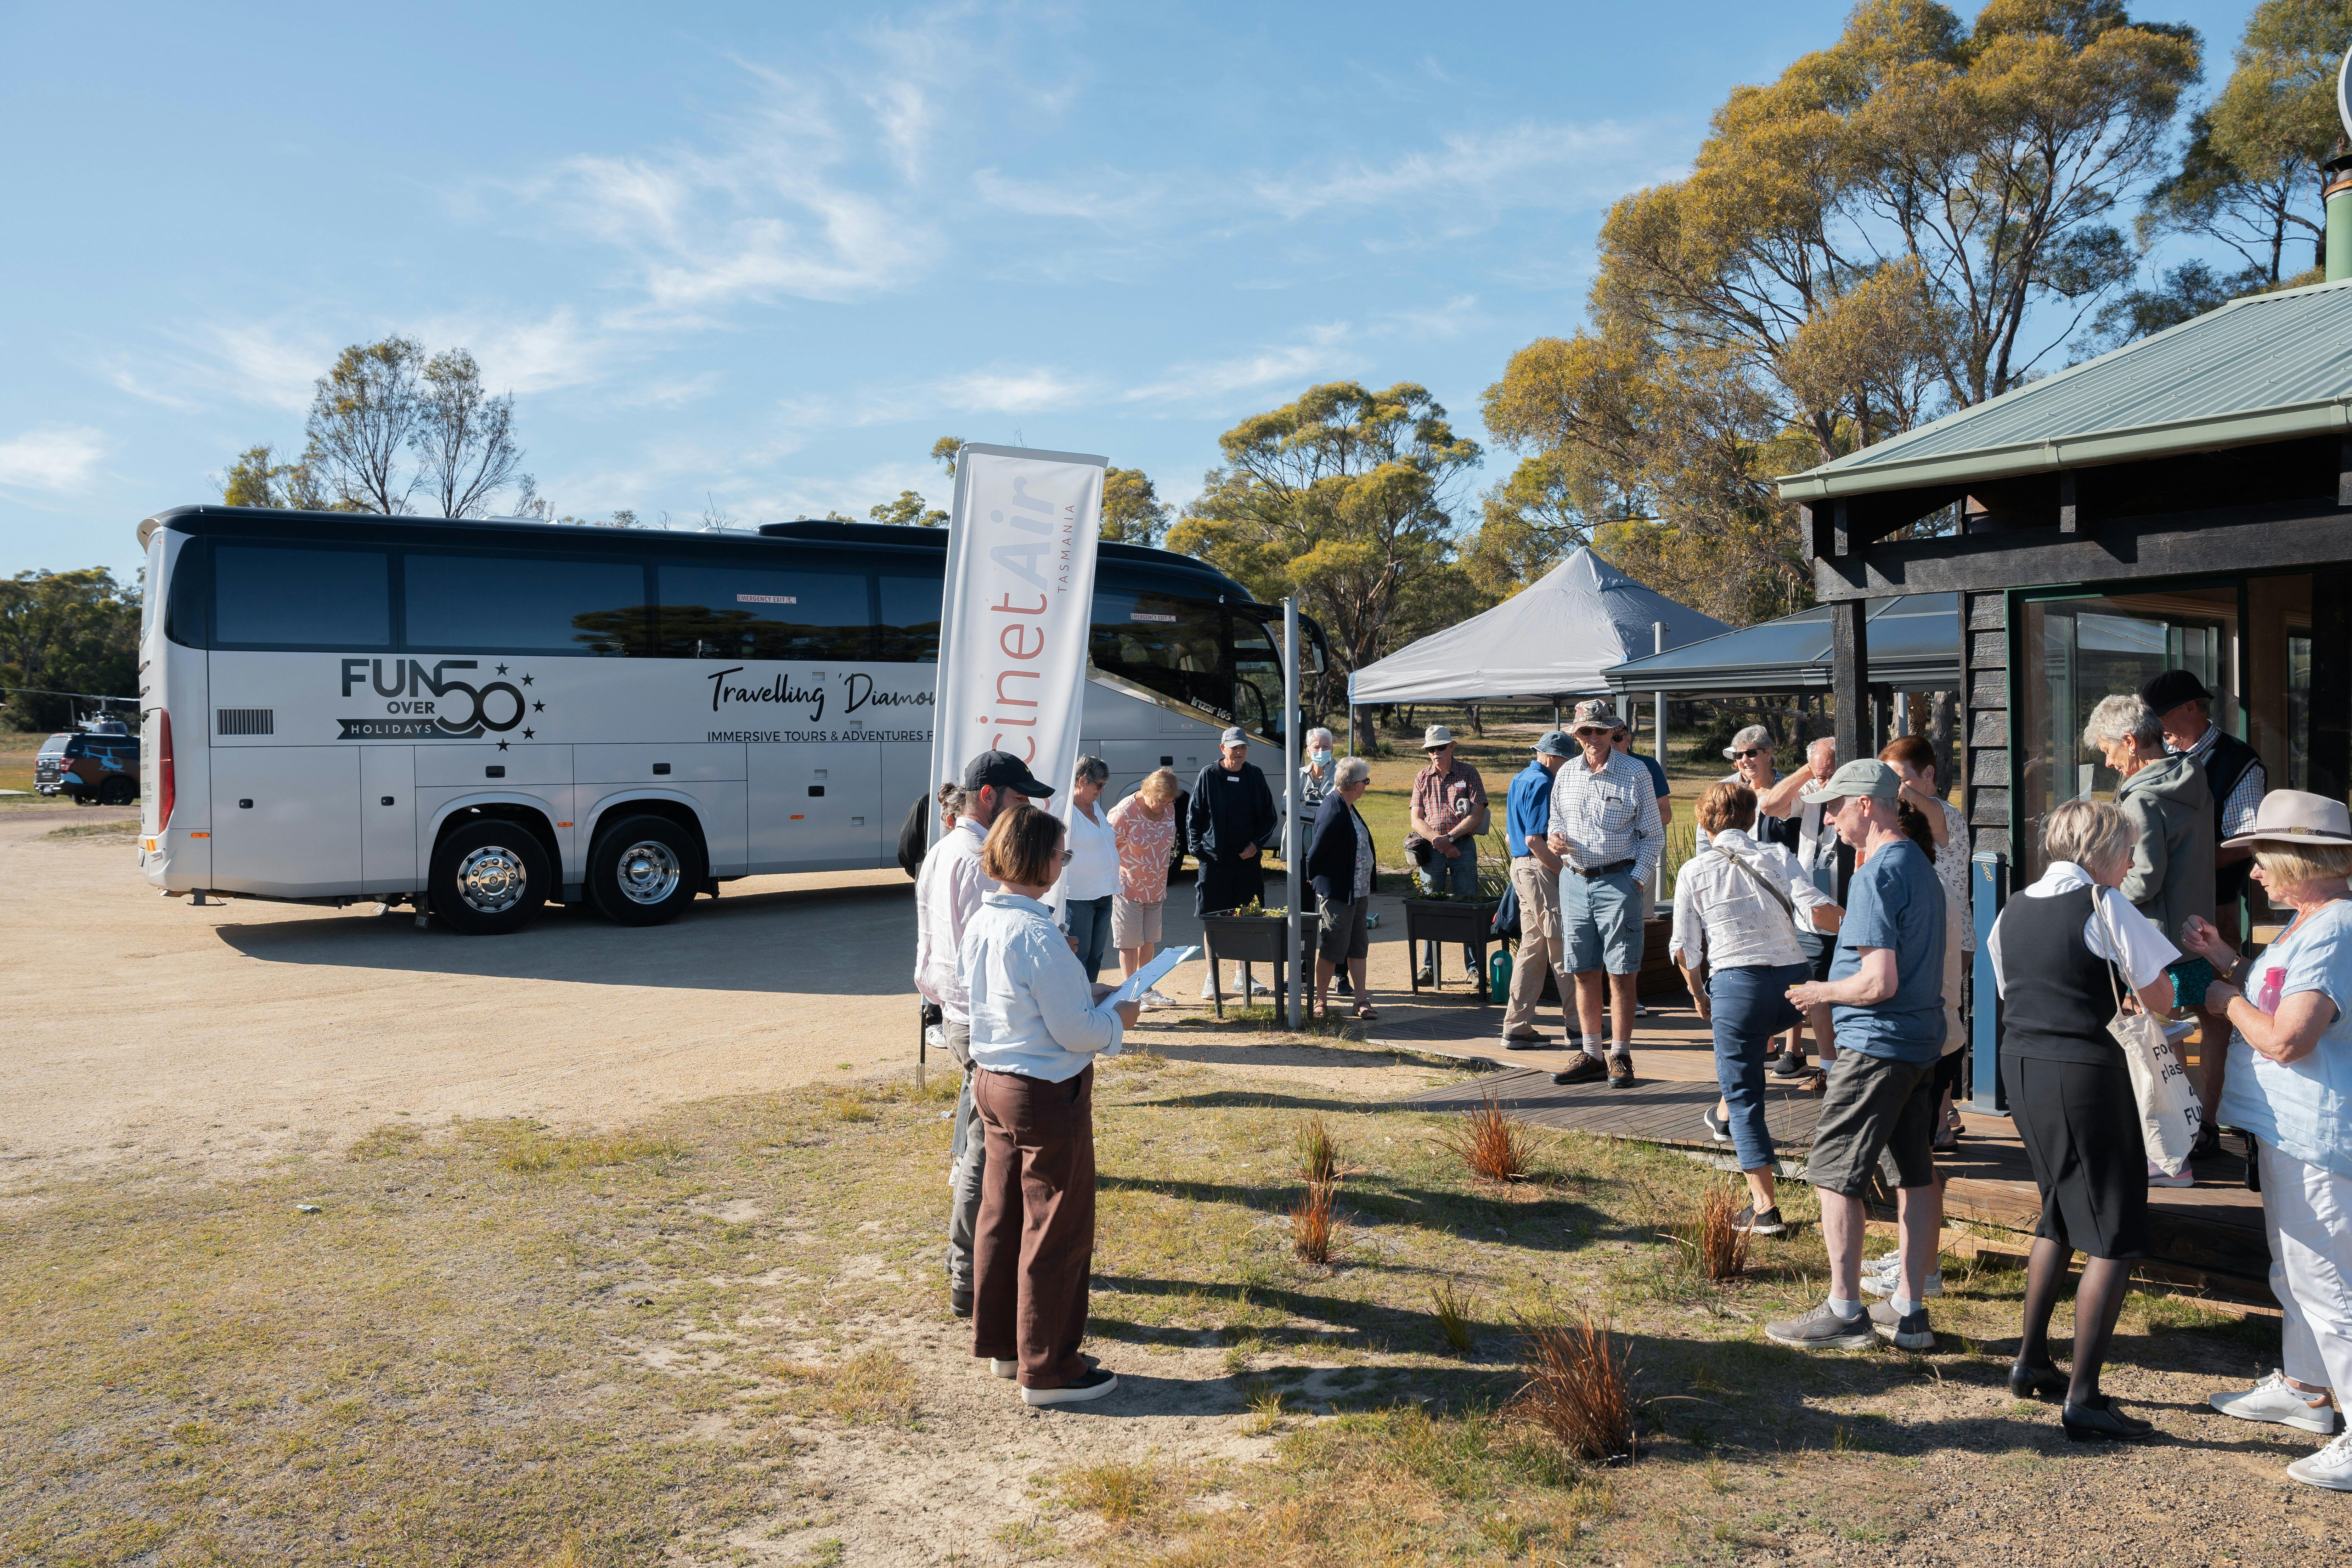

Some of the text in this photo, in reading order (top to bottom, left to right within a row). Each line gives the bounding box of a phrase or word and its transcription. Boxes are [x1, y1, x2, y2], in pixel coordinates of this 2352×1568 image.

[1057, 505, 1075, 593] TASMANIA
[342, 659, 443, 698] FUN
[387, 701, 435, 714] OVER
[433, 660, 525, 732] 50
[708, 667, 824, 722] Travelling
[1217, 708, 1232, 721] i6s
[351, 725, 431, 734] HOLIDAYS
[708, 731, 780, 741] IMMERSIVE
[784, 731, 827, 741] TOURS
[831, 731, 838, 741] &
[842, 731, 923, 741] ADVENTURES
